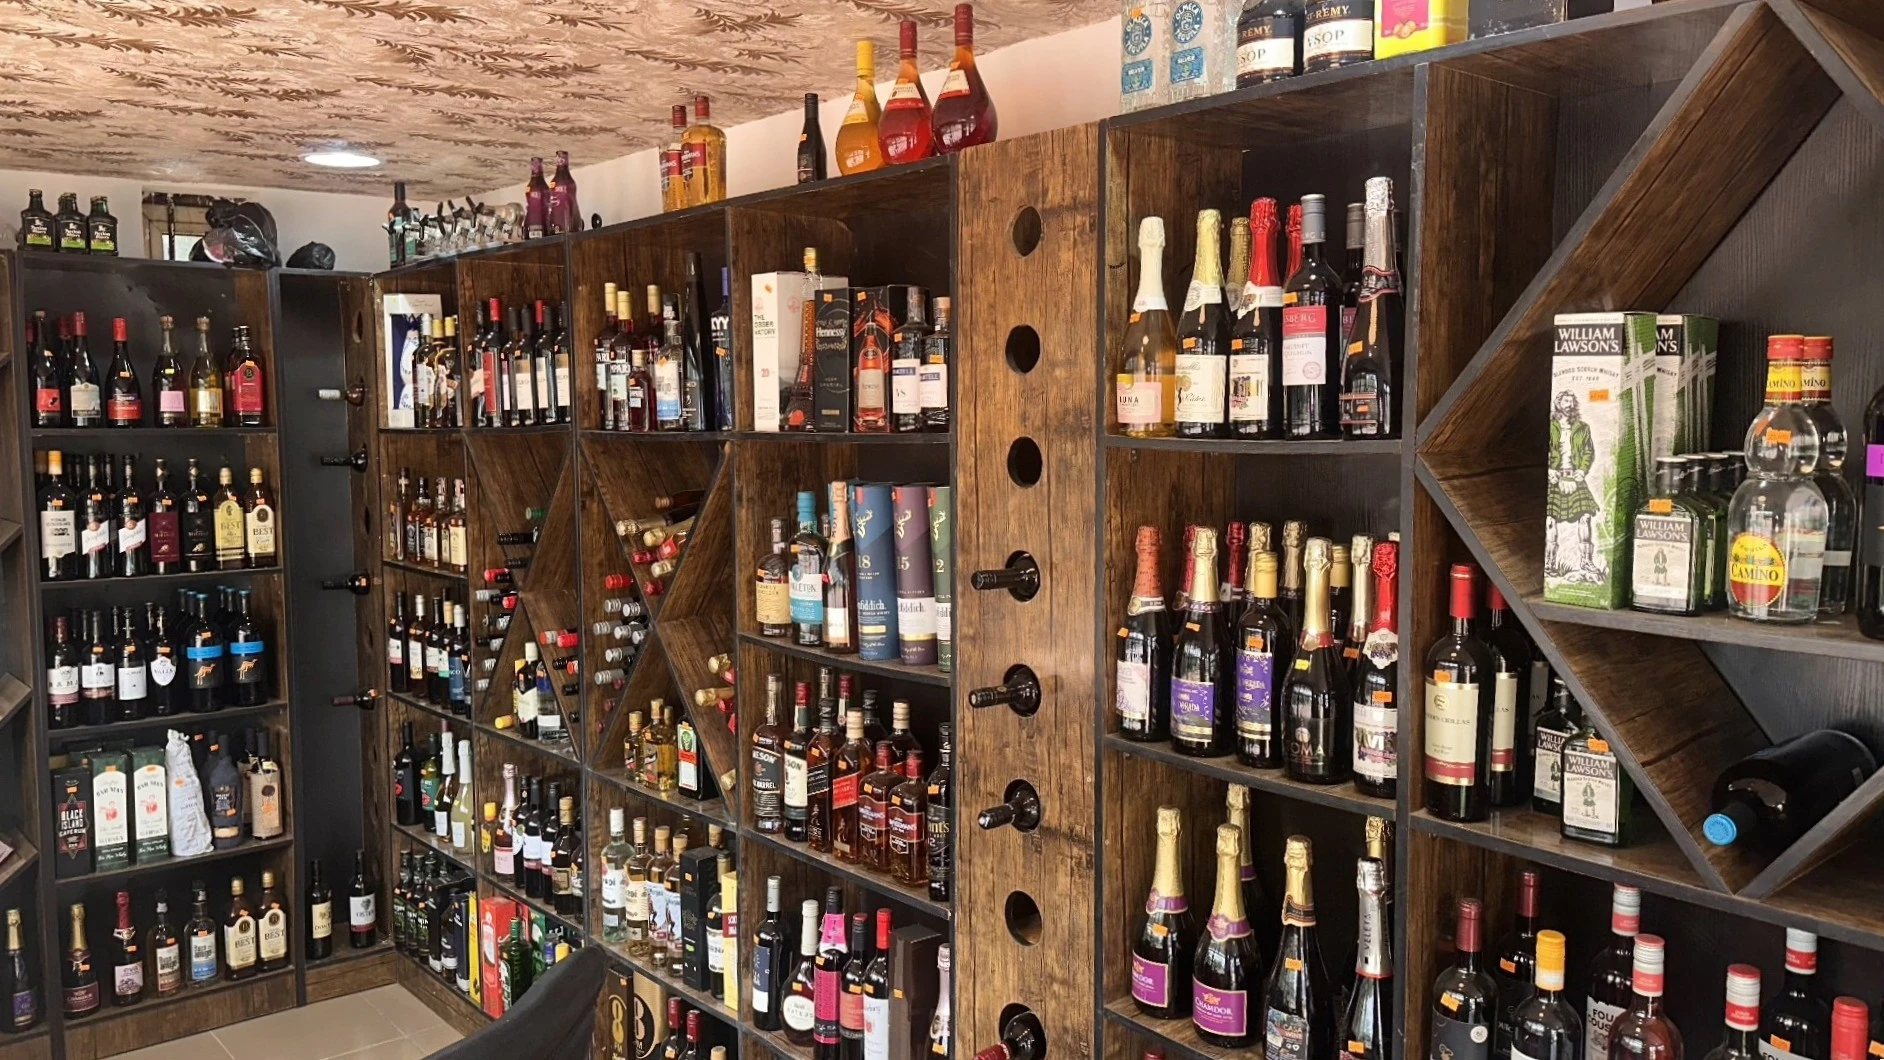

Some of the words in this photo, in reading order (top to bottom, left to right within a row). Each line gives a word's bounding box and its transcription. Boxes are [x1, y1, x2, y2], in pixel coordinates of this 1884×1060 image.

[815, 327, 846, 339] Hennessy
[1559, 327, 1616, 340] WILLIAM
[1555, 340, 1620, 353] LAWSON'S
[221, 520, 240, 530] BEST
[253, 527, 273, 535] BEST
[1639, 520, 1685, 532] WILLIAM
[1636, 529, 1689, 542] LAWSON'S
[1568, 755, 1610, 769] WILLIAM
[1566, 763, 1613, 778] LAWSON'S
[61, 808, 83, 821] BLACK
[61, 818, 84, 829] ISLAND
[265, 930, 284, 940] BEST
[235, 936, 254, 948] BEST
[1195, 996, 1232, 1015] CHAMDOR
